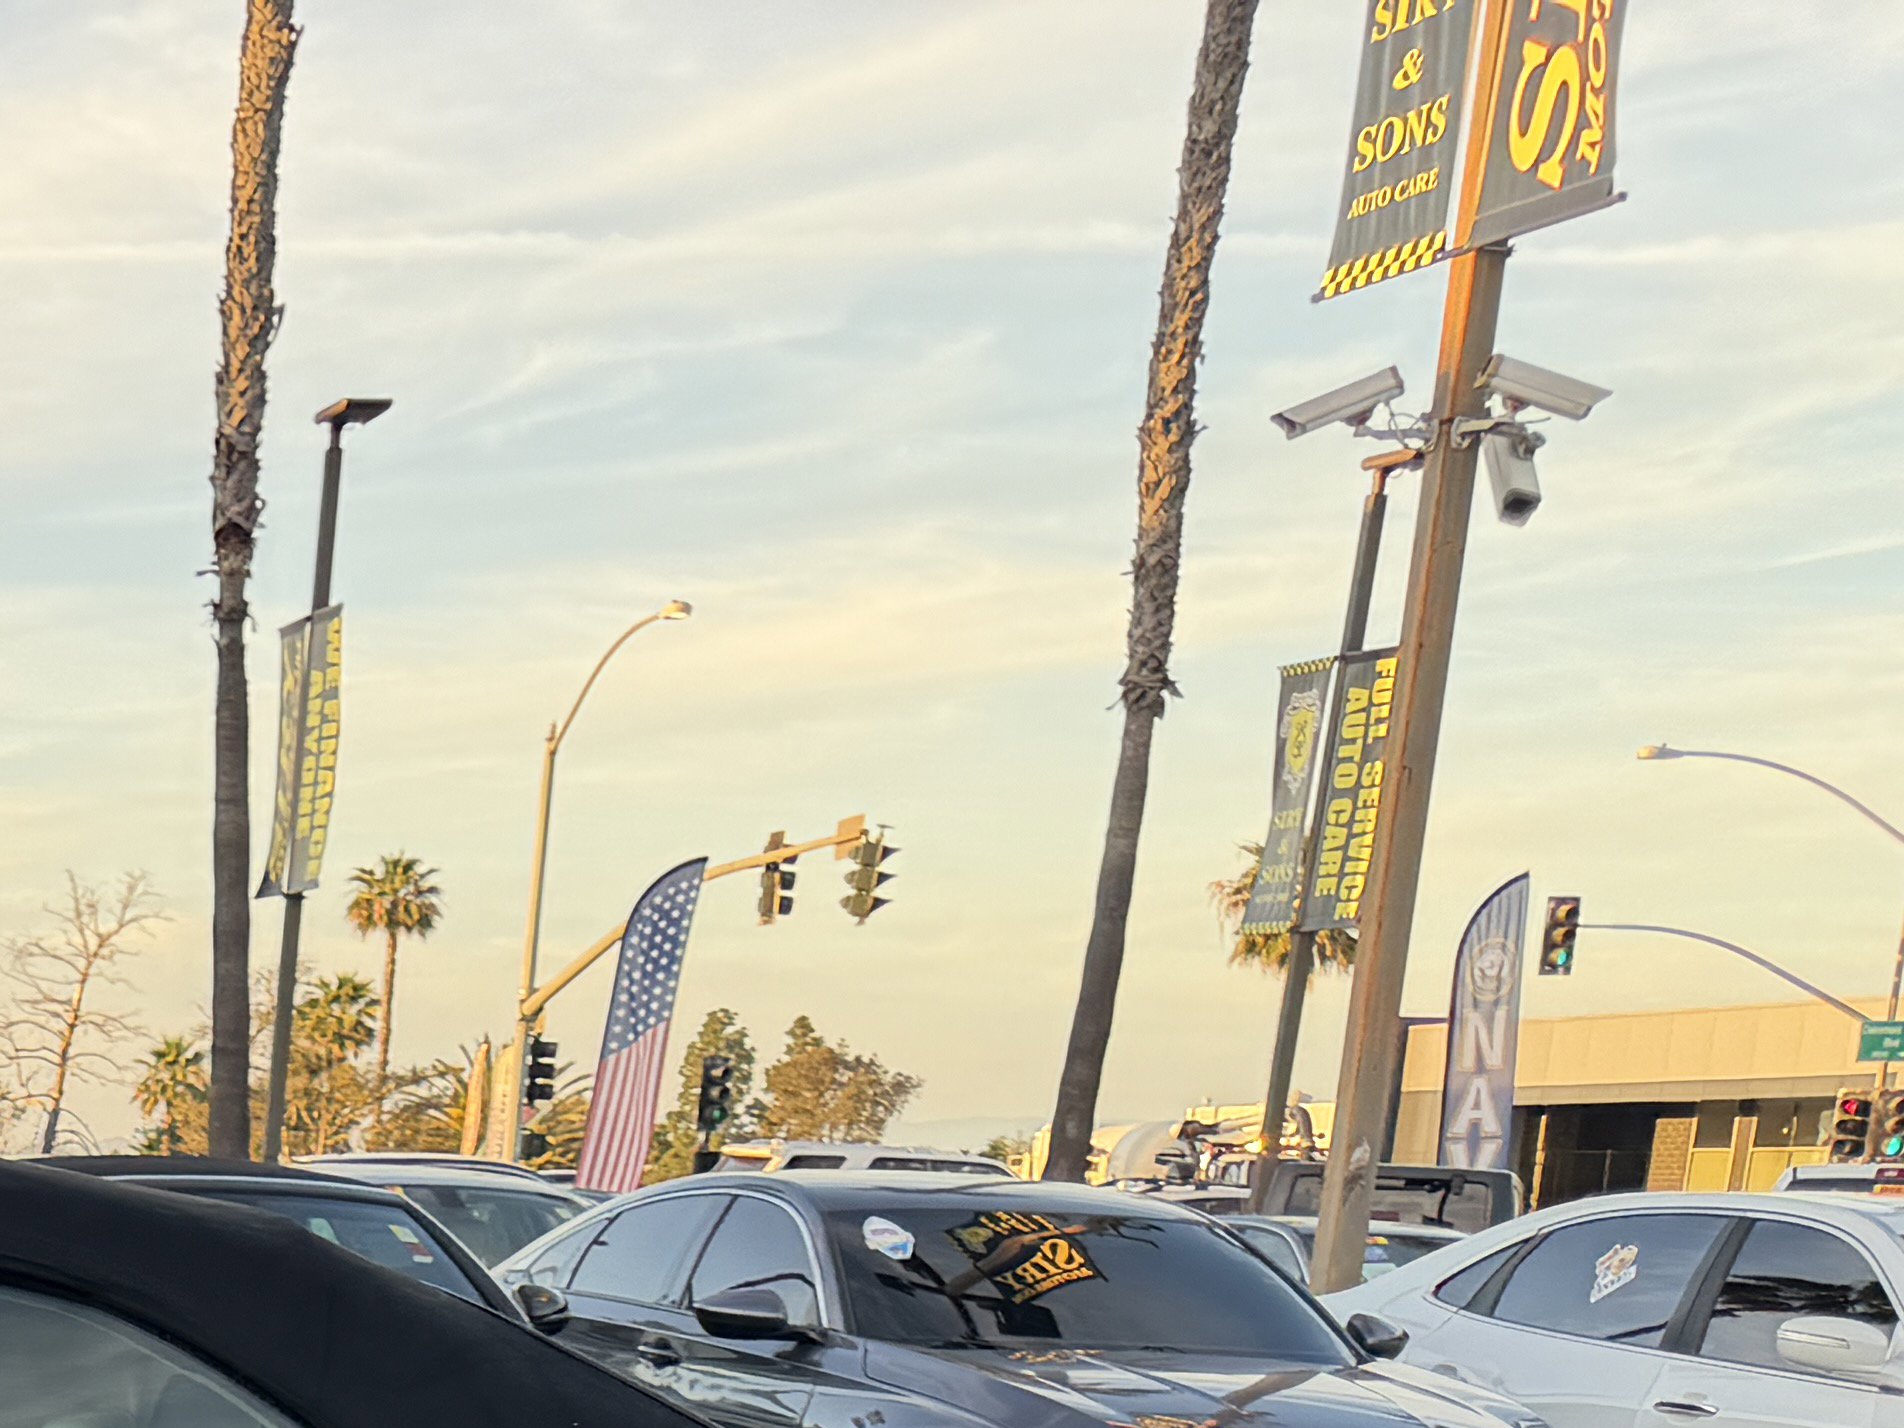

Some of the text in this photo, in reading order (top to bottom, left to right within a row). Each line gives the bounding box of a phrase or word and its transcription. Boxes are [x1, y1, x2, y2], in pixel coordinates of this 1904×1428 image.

[1370, 0, 1455, 43] SI
[1392, 48, 1425, 90] &
[1347, 167, 1440, 220] AUTO CARE
[1352, 93, 1451, 173] SONS
[296, 669, 324, 840] ANYONE
[307, 699, 340, 881] FINANCE
[1315, 687, 1370, 898] AUTO CARE
[1334, 656, 1398, 920] FULL SERVICE
